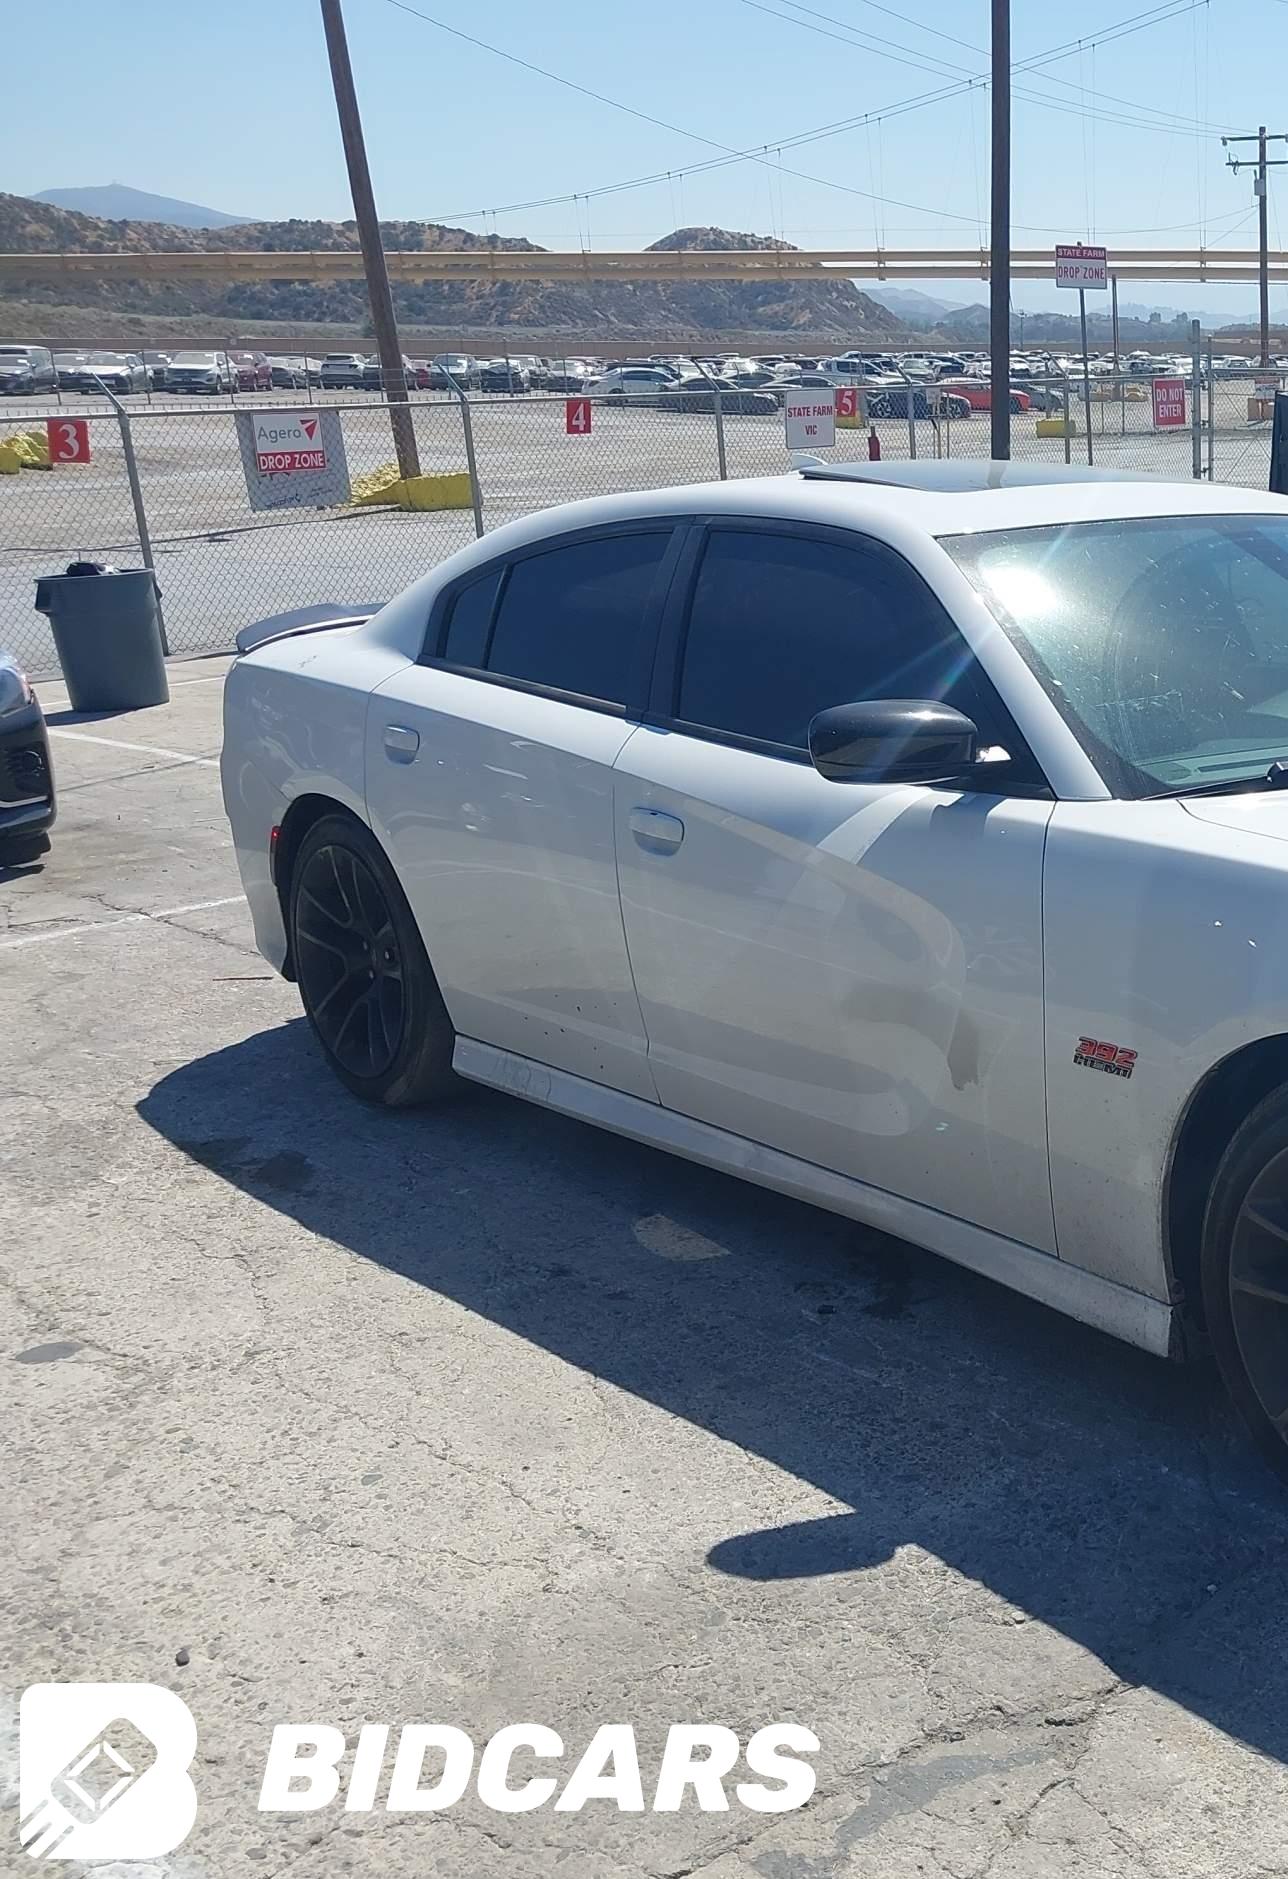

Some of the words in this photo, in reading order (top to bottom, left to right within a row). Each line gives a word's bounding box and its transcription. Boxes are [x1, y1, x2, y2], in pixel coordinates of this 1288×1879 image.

[1057, 248, 1082, 257] STATE
[1083, 249, 1105, 257] FARM
[1058, 266, 1080, 279] DROP
[1083, 267, 1105, 280] ZONE
[841, 390, 853, 415] 5
[1156, 388, 1167, 402] DO
[1169, 388, 1183, 401] NOT
[572, 403, 586, 431] 4
[787, 406, 811, 418] STATE
[812, 405, 833, 417] FARM
[1159, 404, 1182, 417] ENTER
[257, 426, 302, 443] Agero
[805, 425, 818, 436] VIC
[58, 423, 80, 459] 3
[260, 454, 292, 470] DROP
[294, 453, 324, 468] ZONE
[1075, 1036, 1138, 1069] 392
